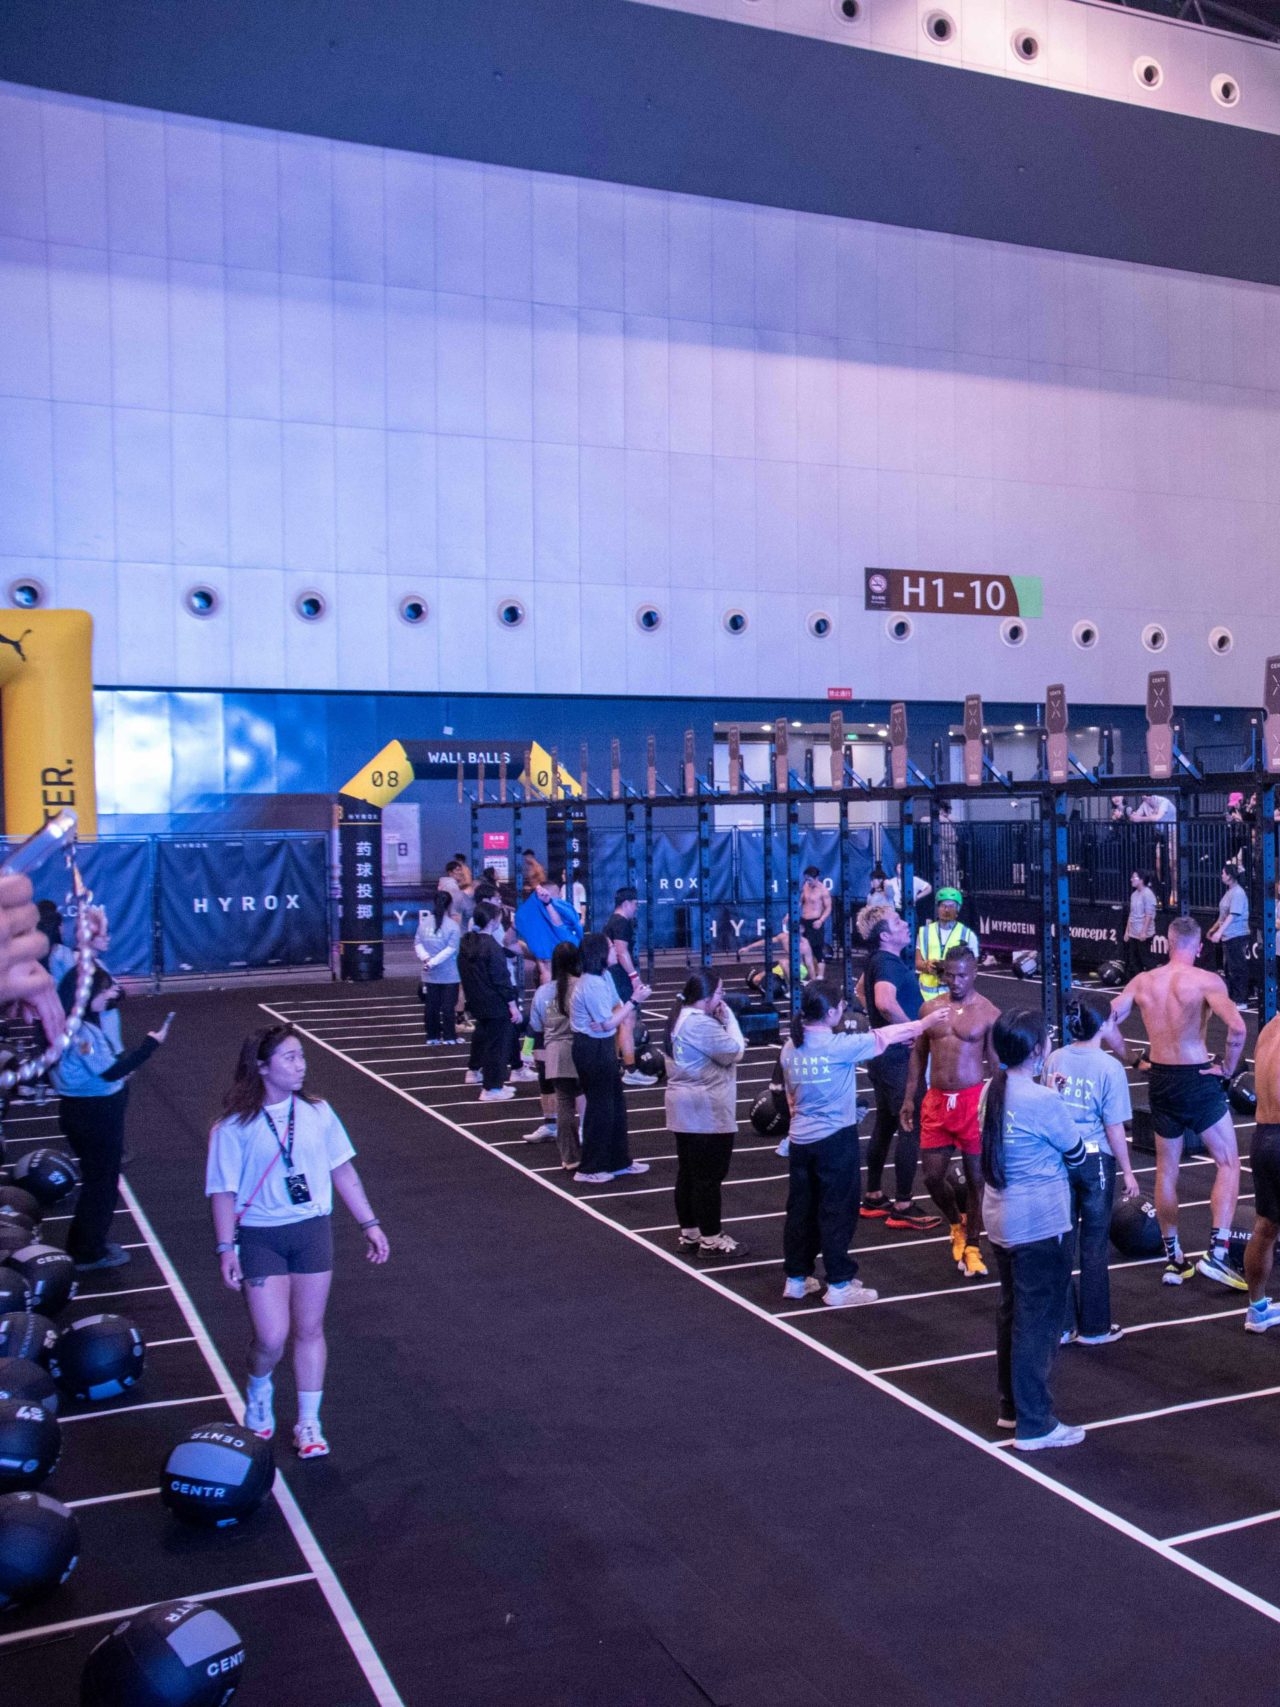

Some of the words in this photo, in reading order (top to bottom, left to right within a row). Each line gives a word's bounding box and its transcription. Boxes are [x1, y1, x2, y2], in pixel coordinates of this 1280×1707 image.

[903, 576, 1006, 611] H1-10
[372, 771, 399, 788] 08
[194, 894, 300, 913] HYROX
[991, 919, 1035, 935] MYPROTEIN
[170, 1480, 226, 1498] CENTR
[206, 1649, 246, 1677] CENT
